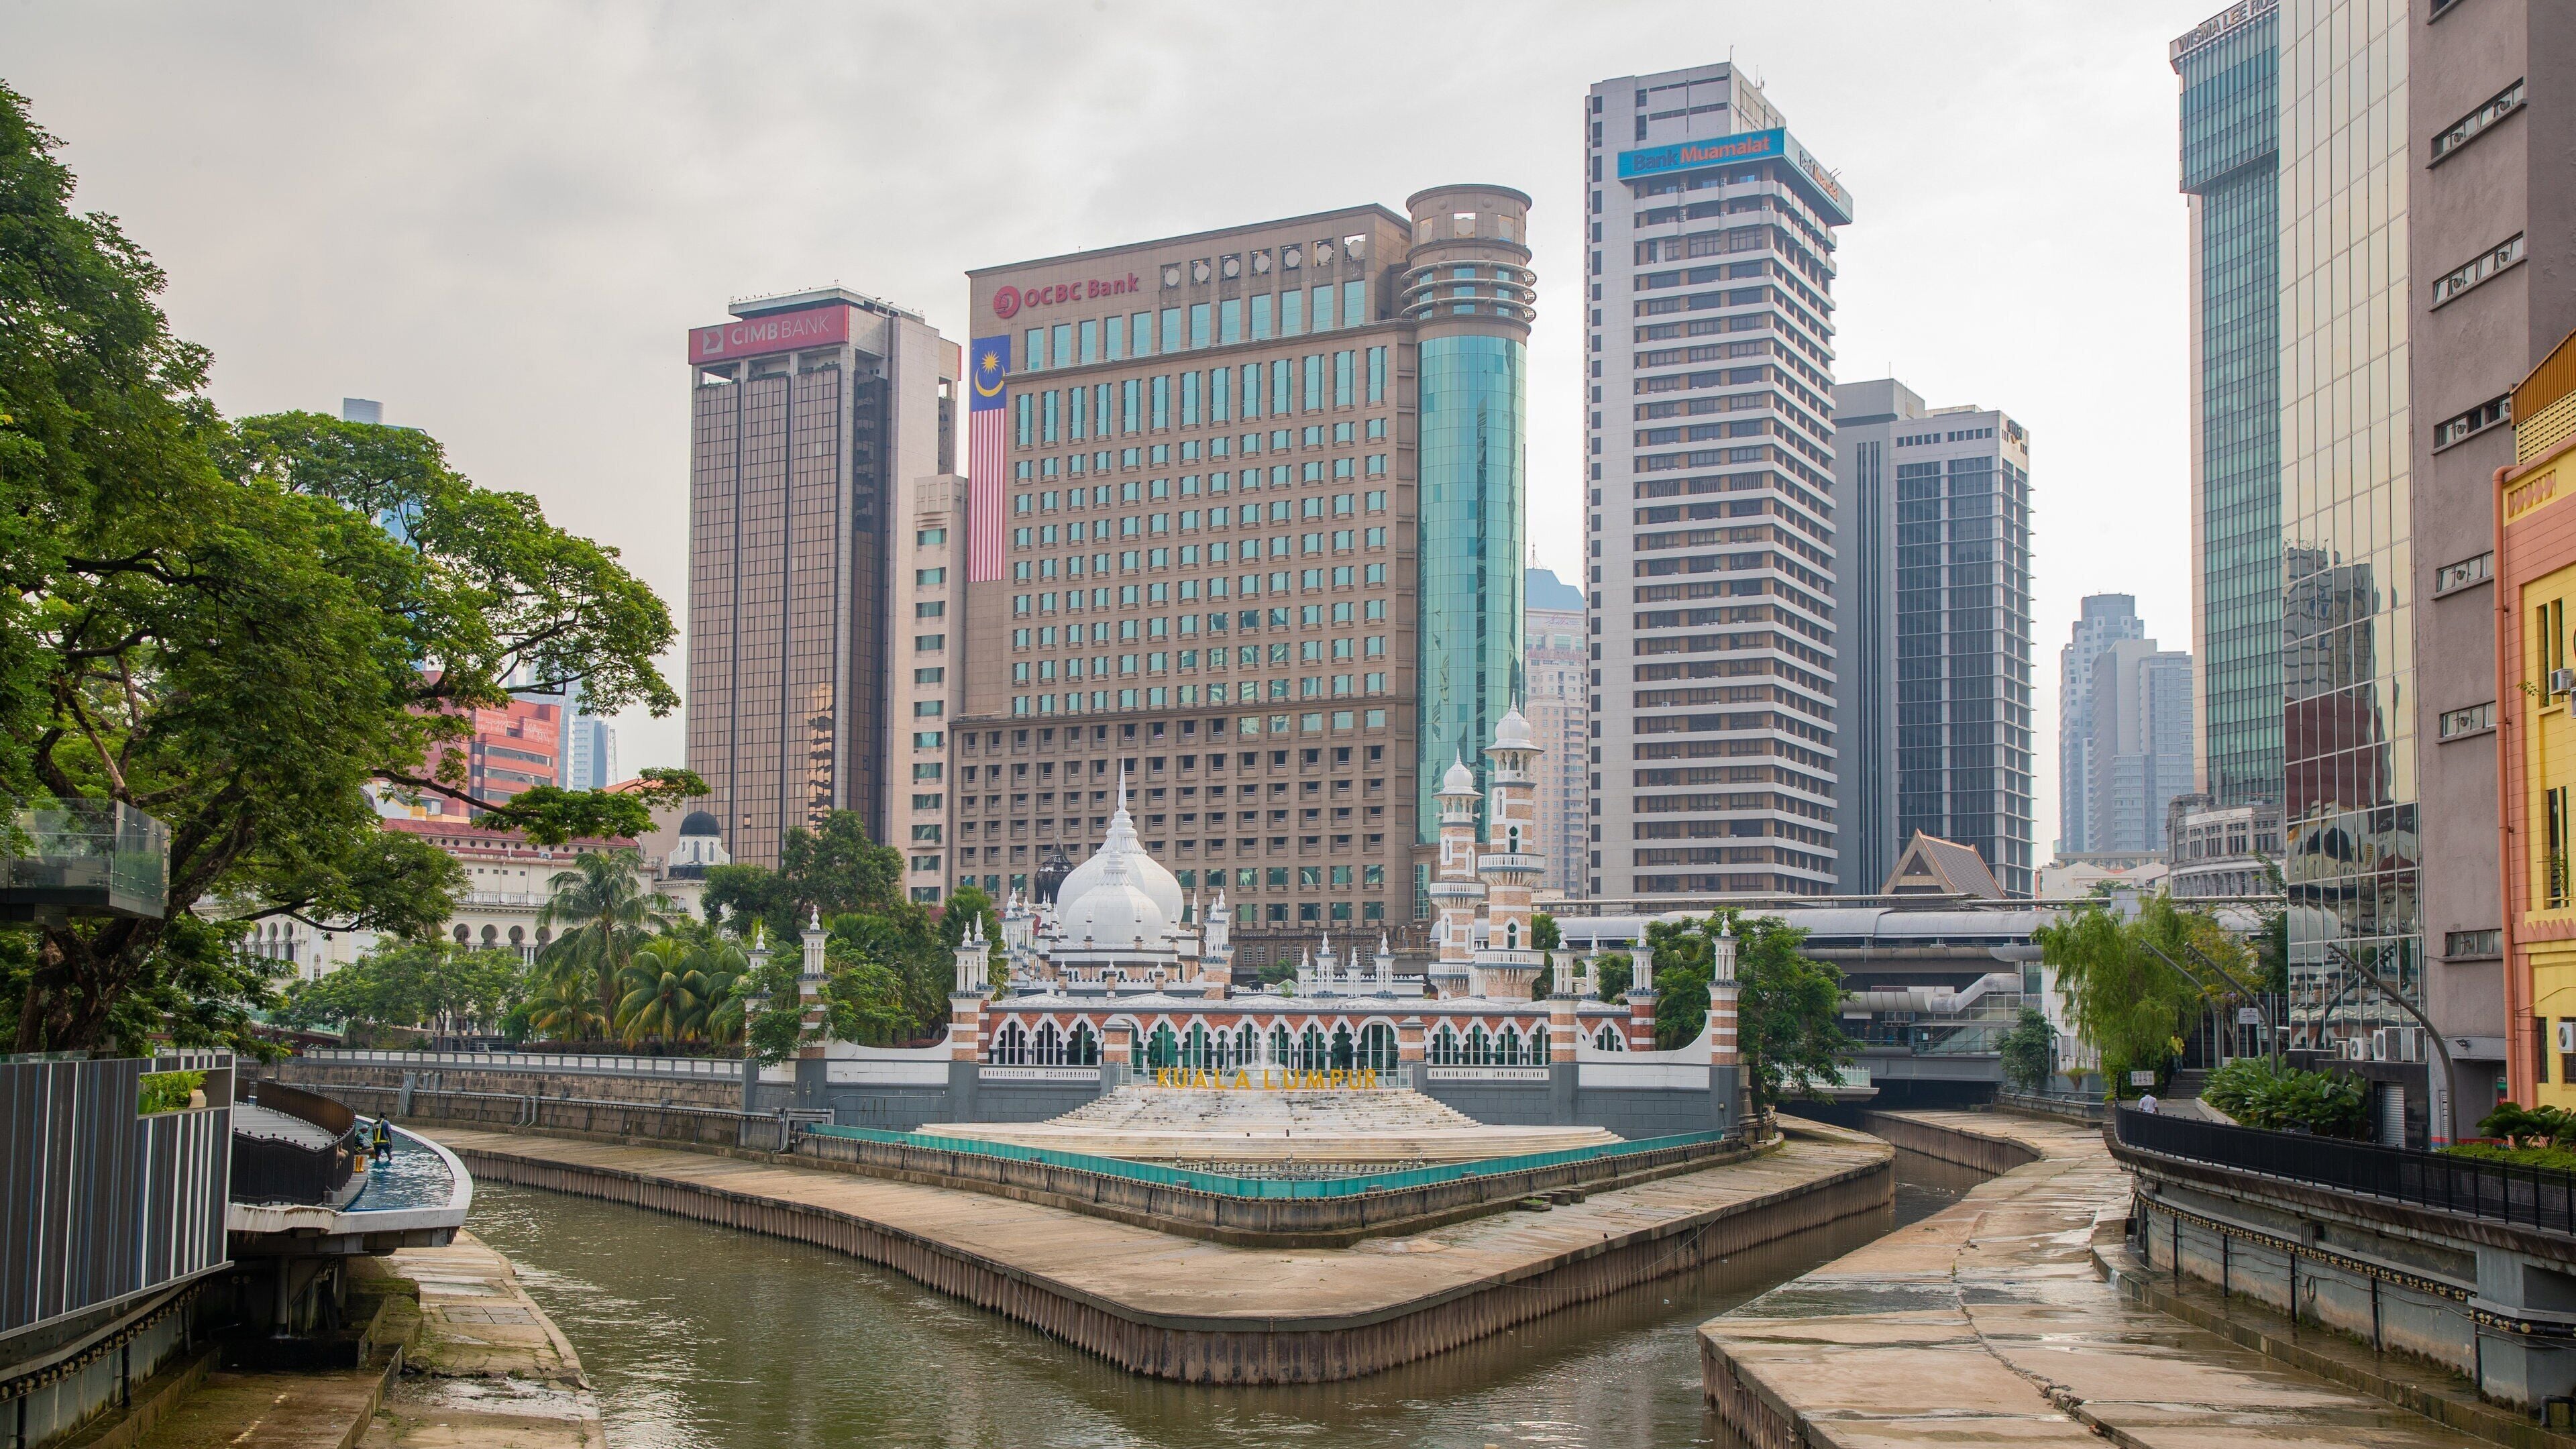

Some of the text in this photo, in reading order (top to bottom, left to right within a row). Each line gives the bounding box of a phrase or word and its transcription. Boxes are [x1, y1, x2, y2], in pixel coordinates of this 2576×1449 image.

[2178, 20, 2220, 52] WISMA
[2222, 3, 2247, 30] LEE
[1633, 136, 1771, 172] Bank Muamalat
[1024, 272, 1139, 307] OCBC Bank
[731, 315, 830, 345] CIMB BANK
[1157, 1067, 1378, 1090] KUALA LUMPUR
